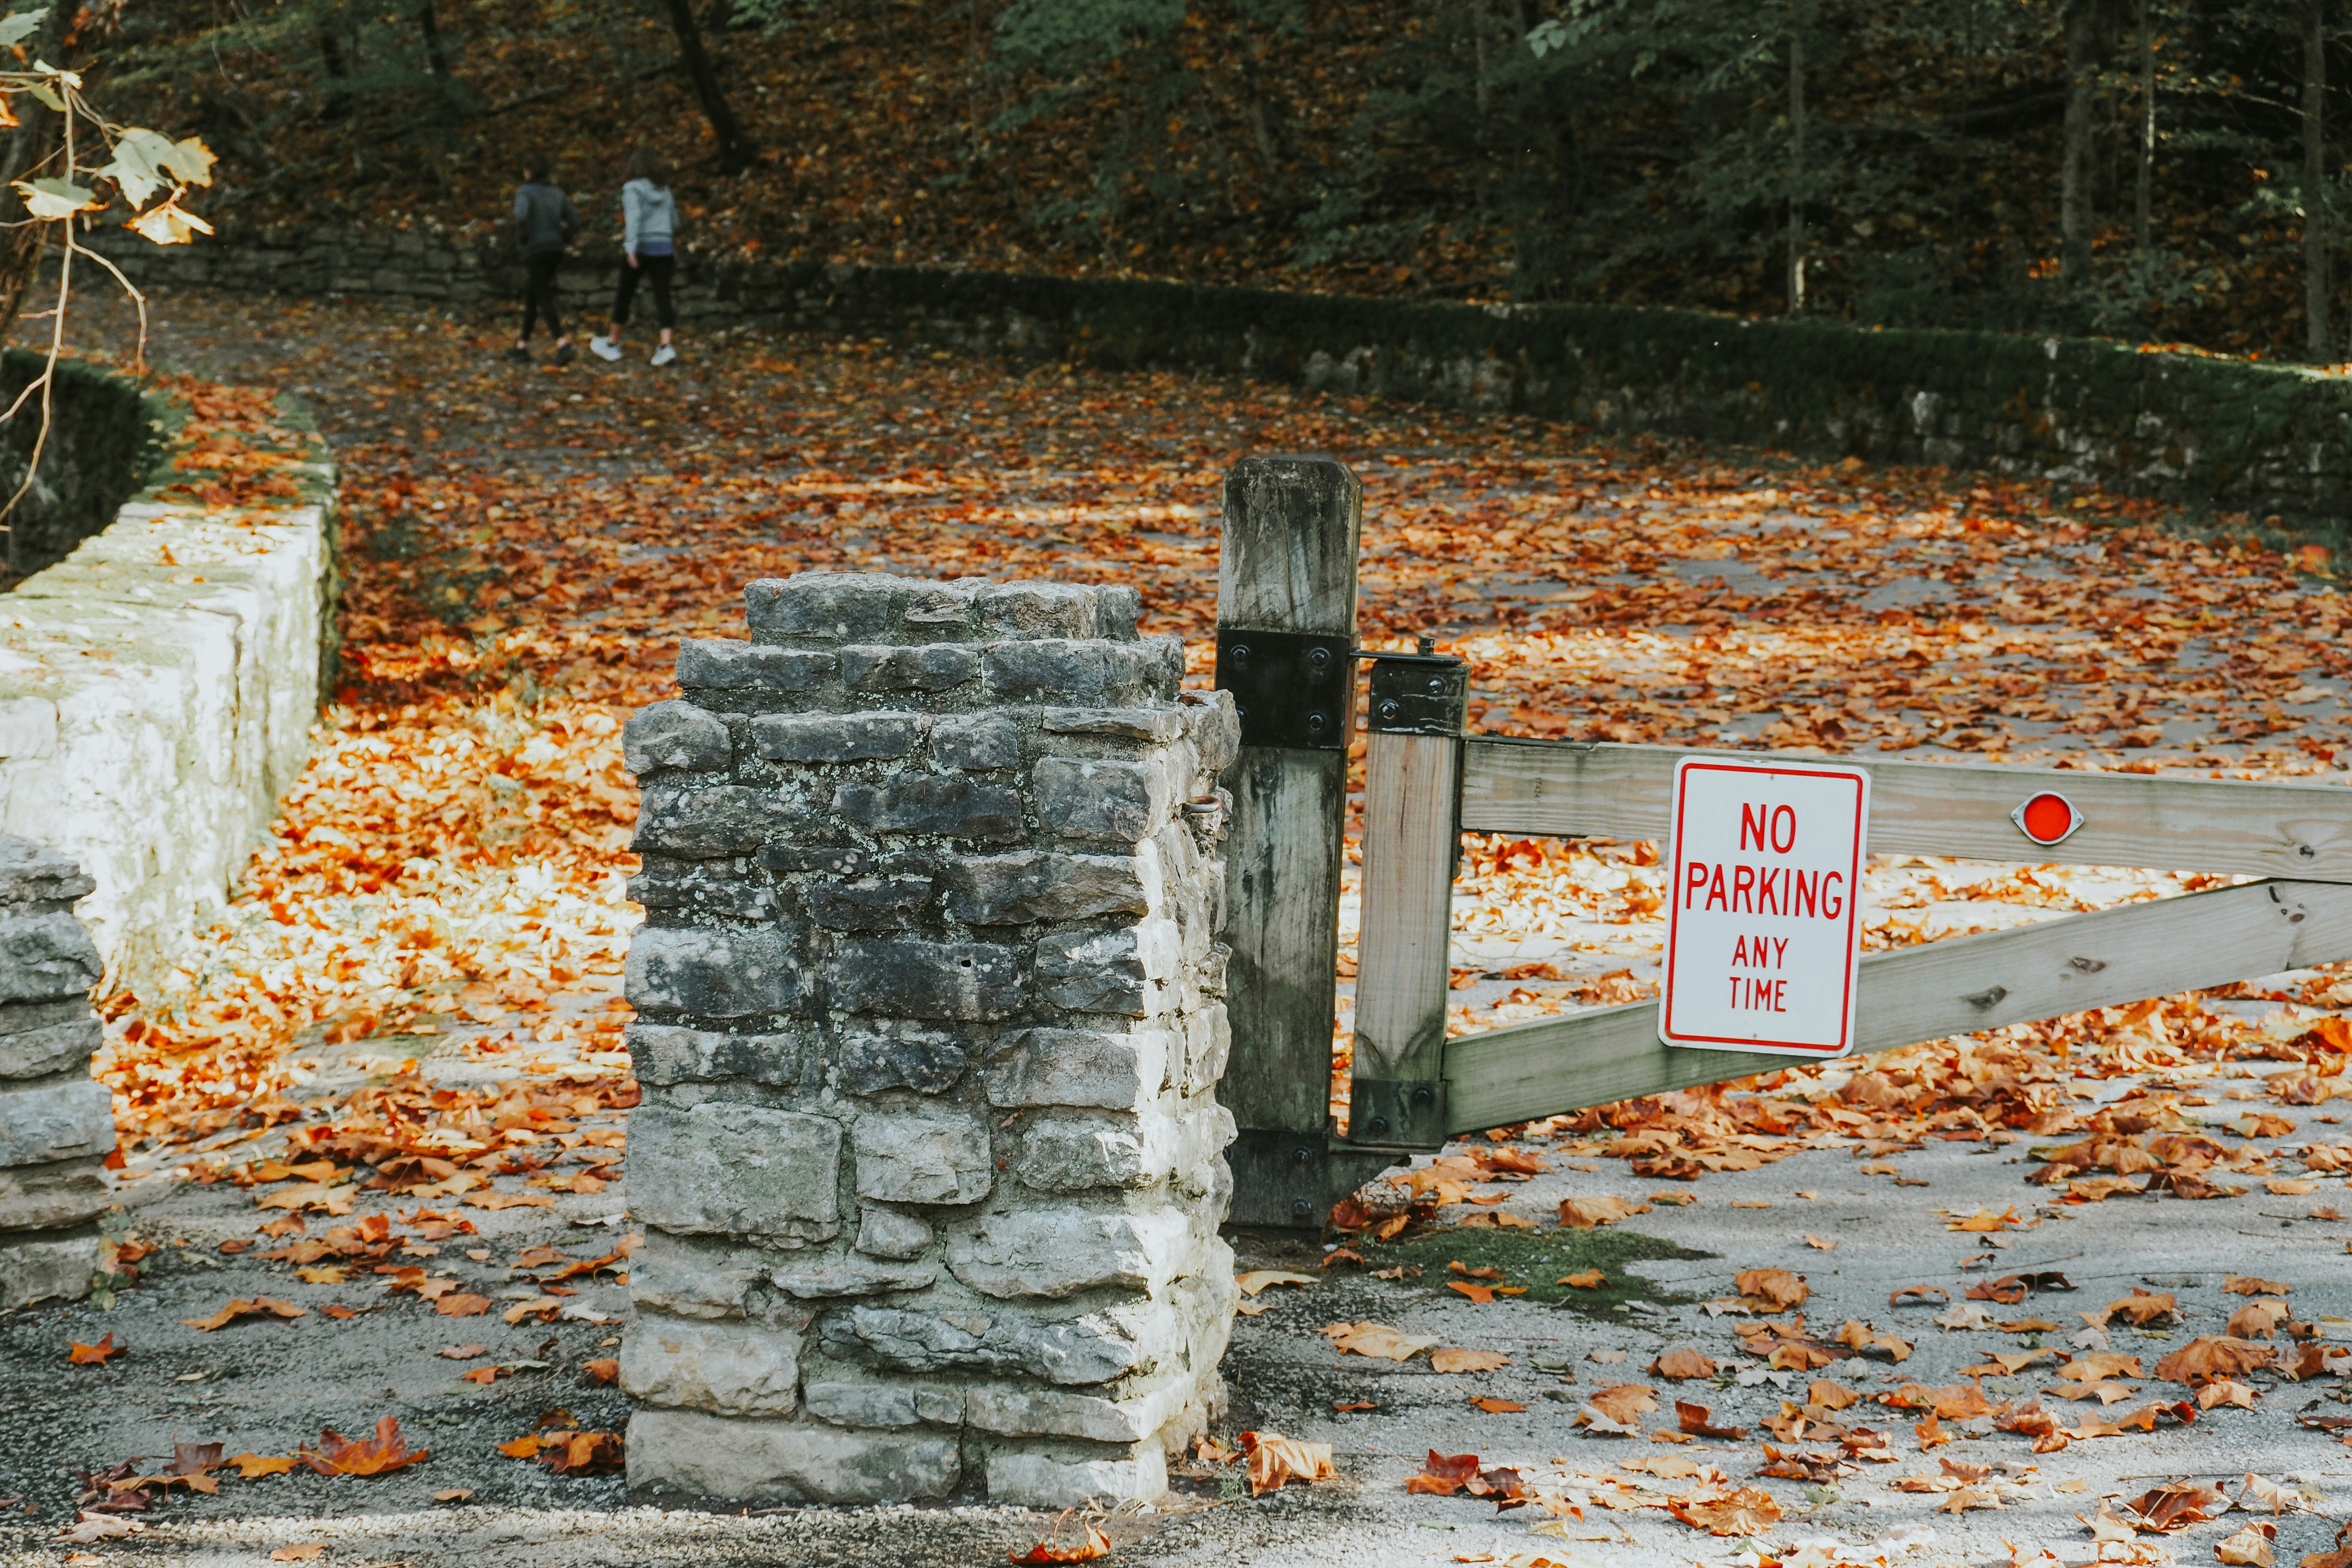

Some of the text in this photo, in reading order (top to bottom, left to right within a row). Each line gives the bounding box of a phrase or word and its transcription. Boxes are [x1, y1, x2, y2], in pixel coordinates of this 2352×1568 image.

[1740, 803, 1796, 854] NO
[1686, 862, 1843, 920] PARKING
[1732, 935, 1789, 969] ANY
[1729, 976, 1788, 1012] TIME
